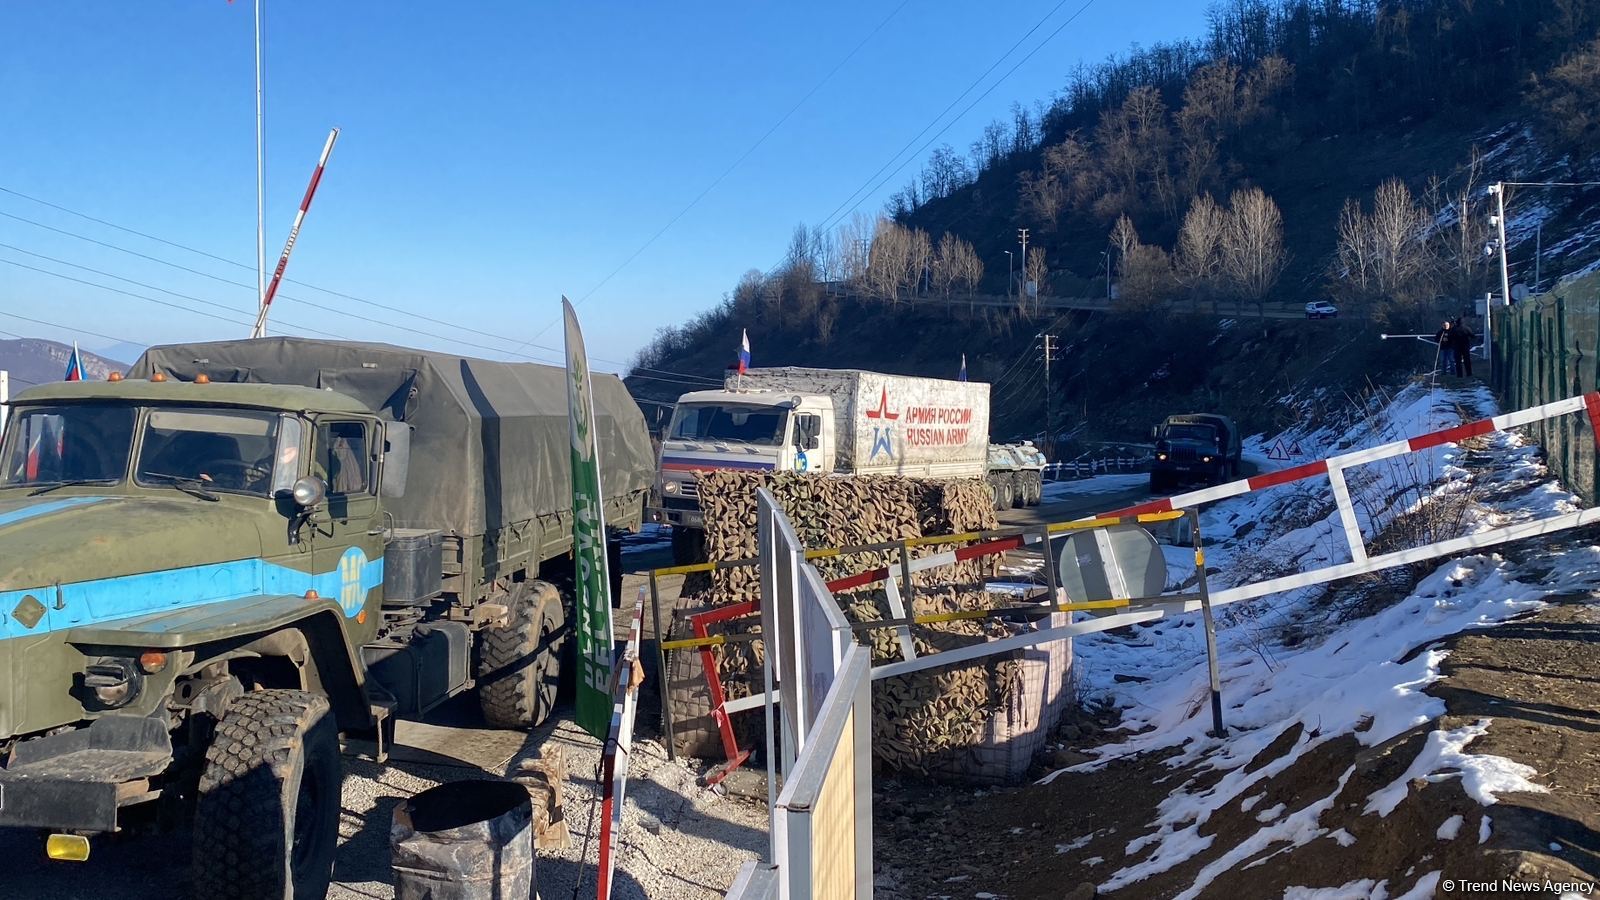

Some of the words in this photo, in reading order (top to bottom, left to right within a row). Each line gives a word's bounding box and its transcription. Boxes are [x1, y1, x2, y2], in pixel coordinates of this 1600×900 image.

[906, 406, 936, 423] АРМИЯ
[938, 408, 972, 425] РОССИИ
[907, 428, 945, 446] RUSSIAN
[946, 428, 970, 445] ARMY
